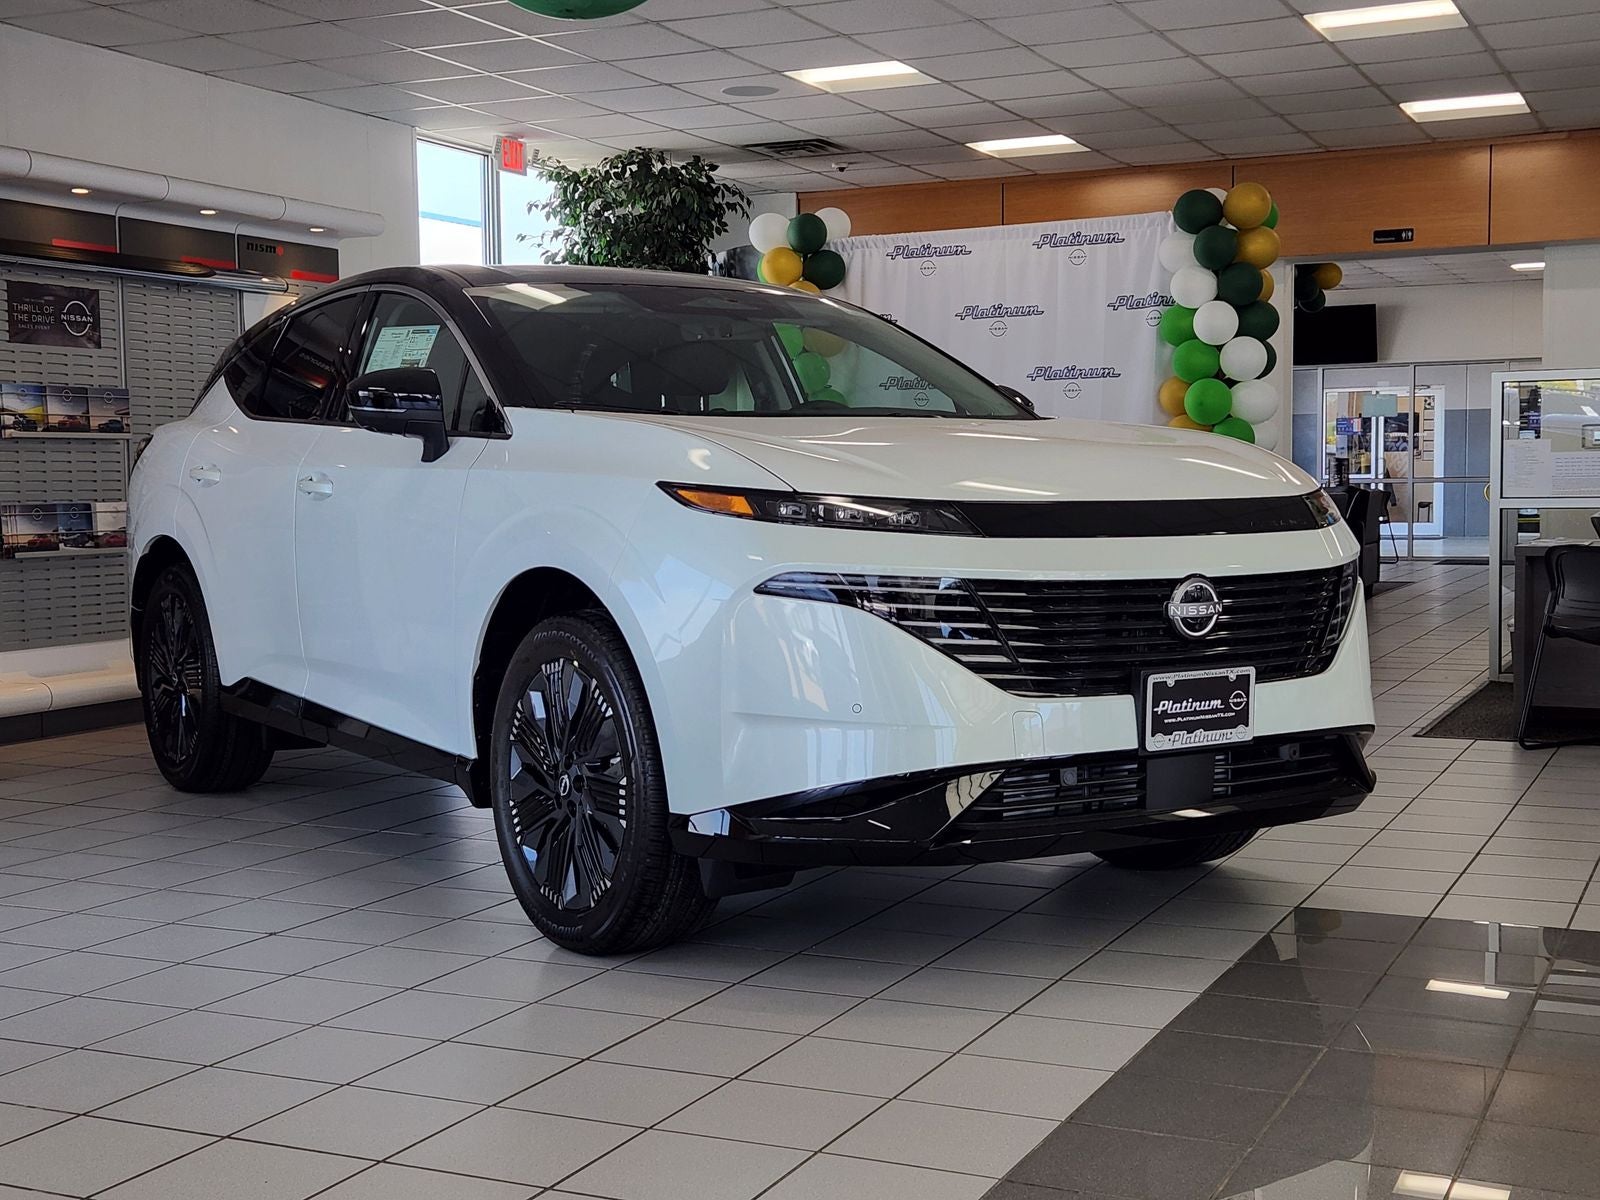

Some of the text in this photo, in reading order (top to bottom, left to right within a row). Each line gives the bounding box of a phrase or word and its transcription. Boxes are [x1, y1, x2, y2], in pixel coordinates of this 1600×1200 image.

[501, 137, 523, 170] EXIT
[1032, 231, 1126, 249] Platinum
[886, 243, 972, 260] Platinum
[12, 303, 55, 314] THRILL OF
[955, 303, 1044, 320] Platinum
[12, 313, 55, 324] THE DRIVE
[60, 313, 93, 322] NISSAN
[1026, 364, 1122, 381] Platinum
[1170, 603, 1223, 616] NISSAN
[1152, 668, 1250, 681] www.PlatinumNissanTX.com
[1153, 698, 1225, 715] Platinum
[1172, 729, 1232, 746] Platinum
